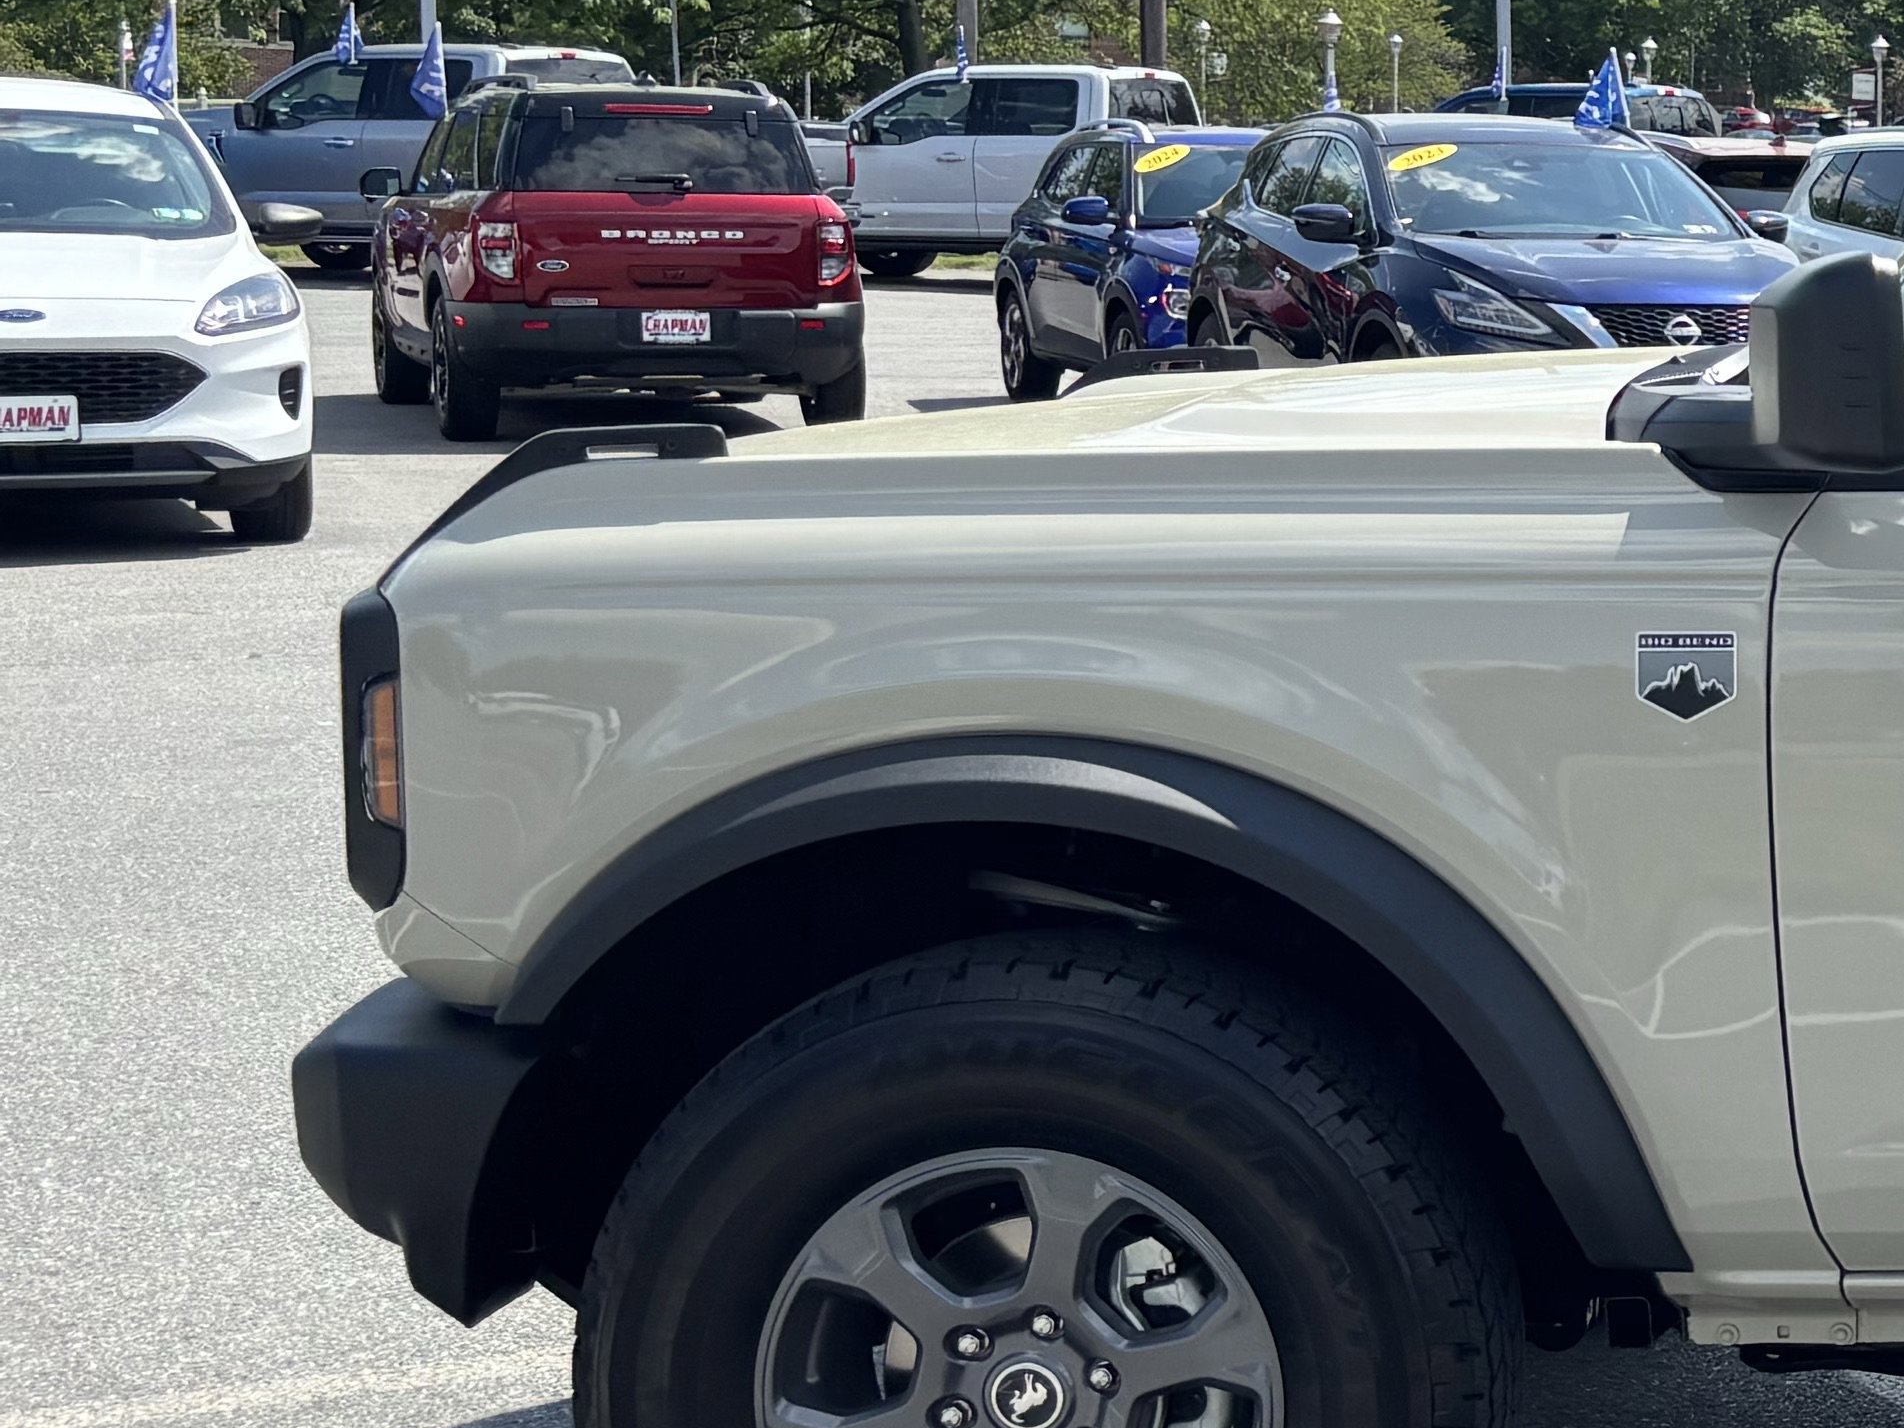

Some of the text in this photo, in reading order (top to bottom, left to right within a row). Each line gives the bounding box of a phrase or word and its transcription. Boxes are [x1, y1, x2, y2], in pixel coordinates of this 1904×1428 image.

[1144, 147, 1179, 169] 2024
[601, 229, 744, 239] BRONCO
[645, 316, 707, 333] CHAPMAN
[0, 405, 71, 427] APMAN
